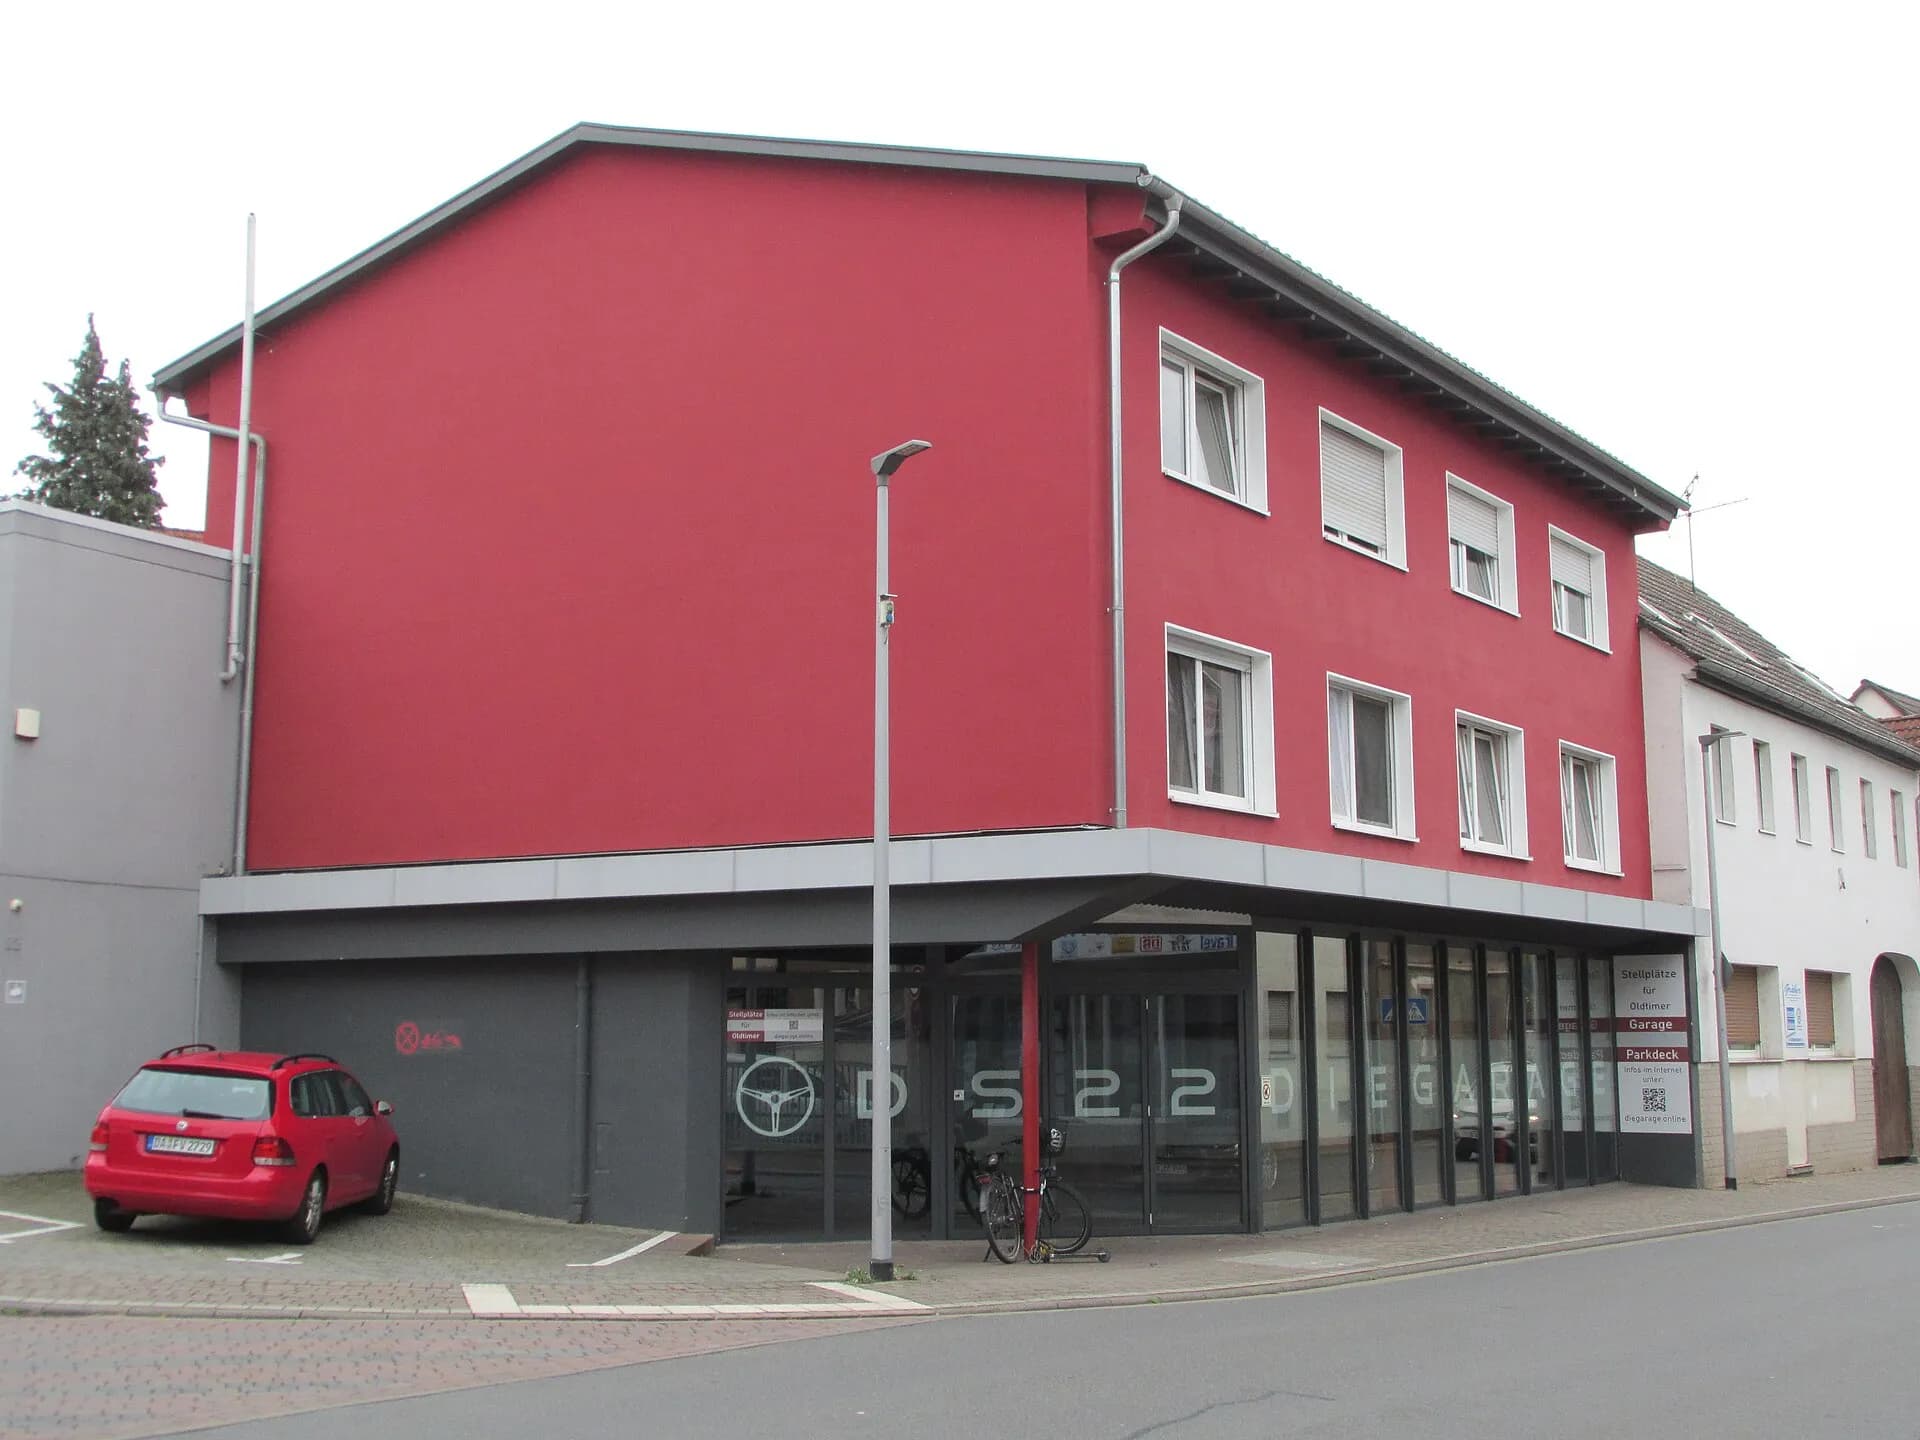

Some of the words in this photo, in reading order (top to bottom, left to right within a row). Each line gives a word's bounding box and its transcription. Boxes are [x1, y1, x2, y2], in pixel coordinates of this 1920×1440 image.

[1621, 969, 1677, 981] Stellplätze
[1642, 986, 1657, 995] für
[1629, 1001, 1672, 1011] Oldtimer
[741, 1021, 751, 1029] für
[1629, 1018, 1673, 1032] Garage
[732, 1031, 760, 1039] Oldtimer
[1626, 1049, 1680, 1060] Parkdeck
[1624, 1065, 1642, 1074] Infos
